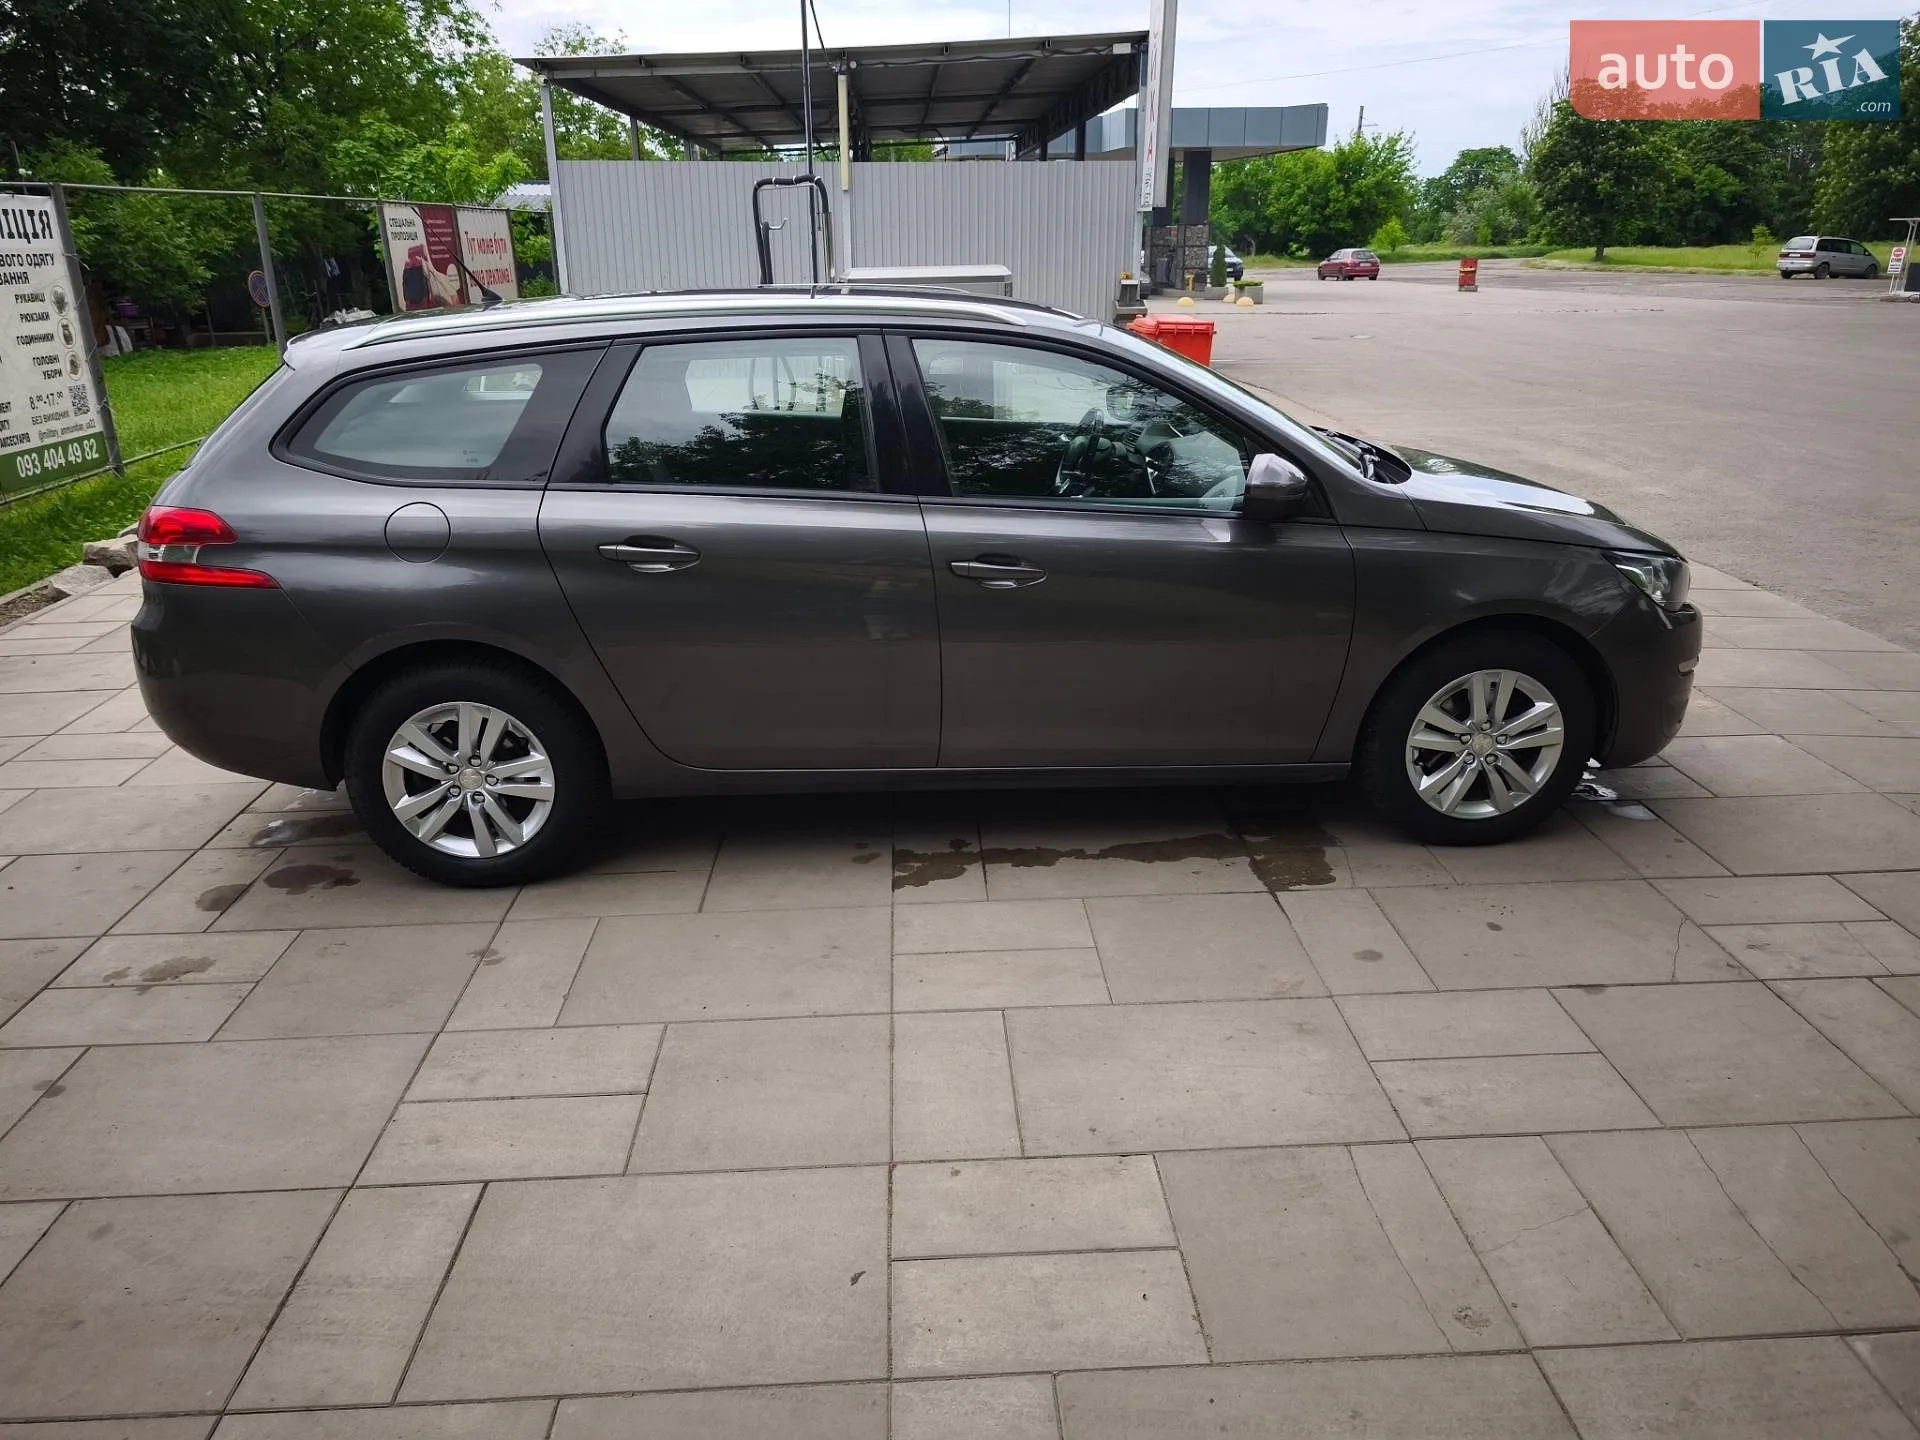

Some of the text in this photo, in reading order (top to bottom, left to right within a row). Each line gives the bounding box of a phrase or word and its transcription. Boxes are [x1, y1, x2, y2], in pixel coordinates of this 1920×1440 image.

[0, 208, 54, 244] ІЦІЯ
[26, 253, 55, 269] ОДЯГУ
[20, 312, 50, 323] РЮКЗАКИ
[16, 333, 55, 346] ГОДИННИКИ
[33, 354, 60, 367] ГОЛОВНІ
[43, 368, 63, 380] УБОРИ
[16, 438, 99, 478] 093 404 49 82
